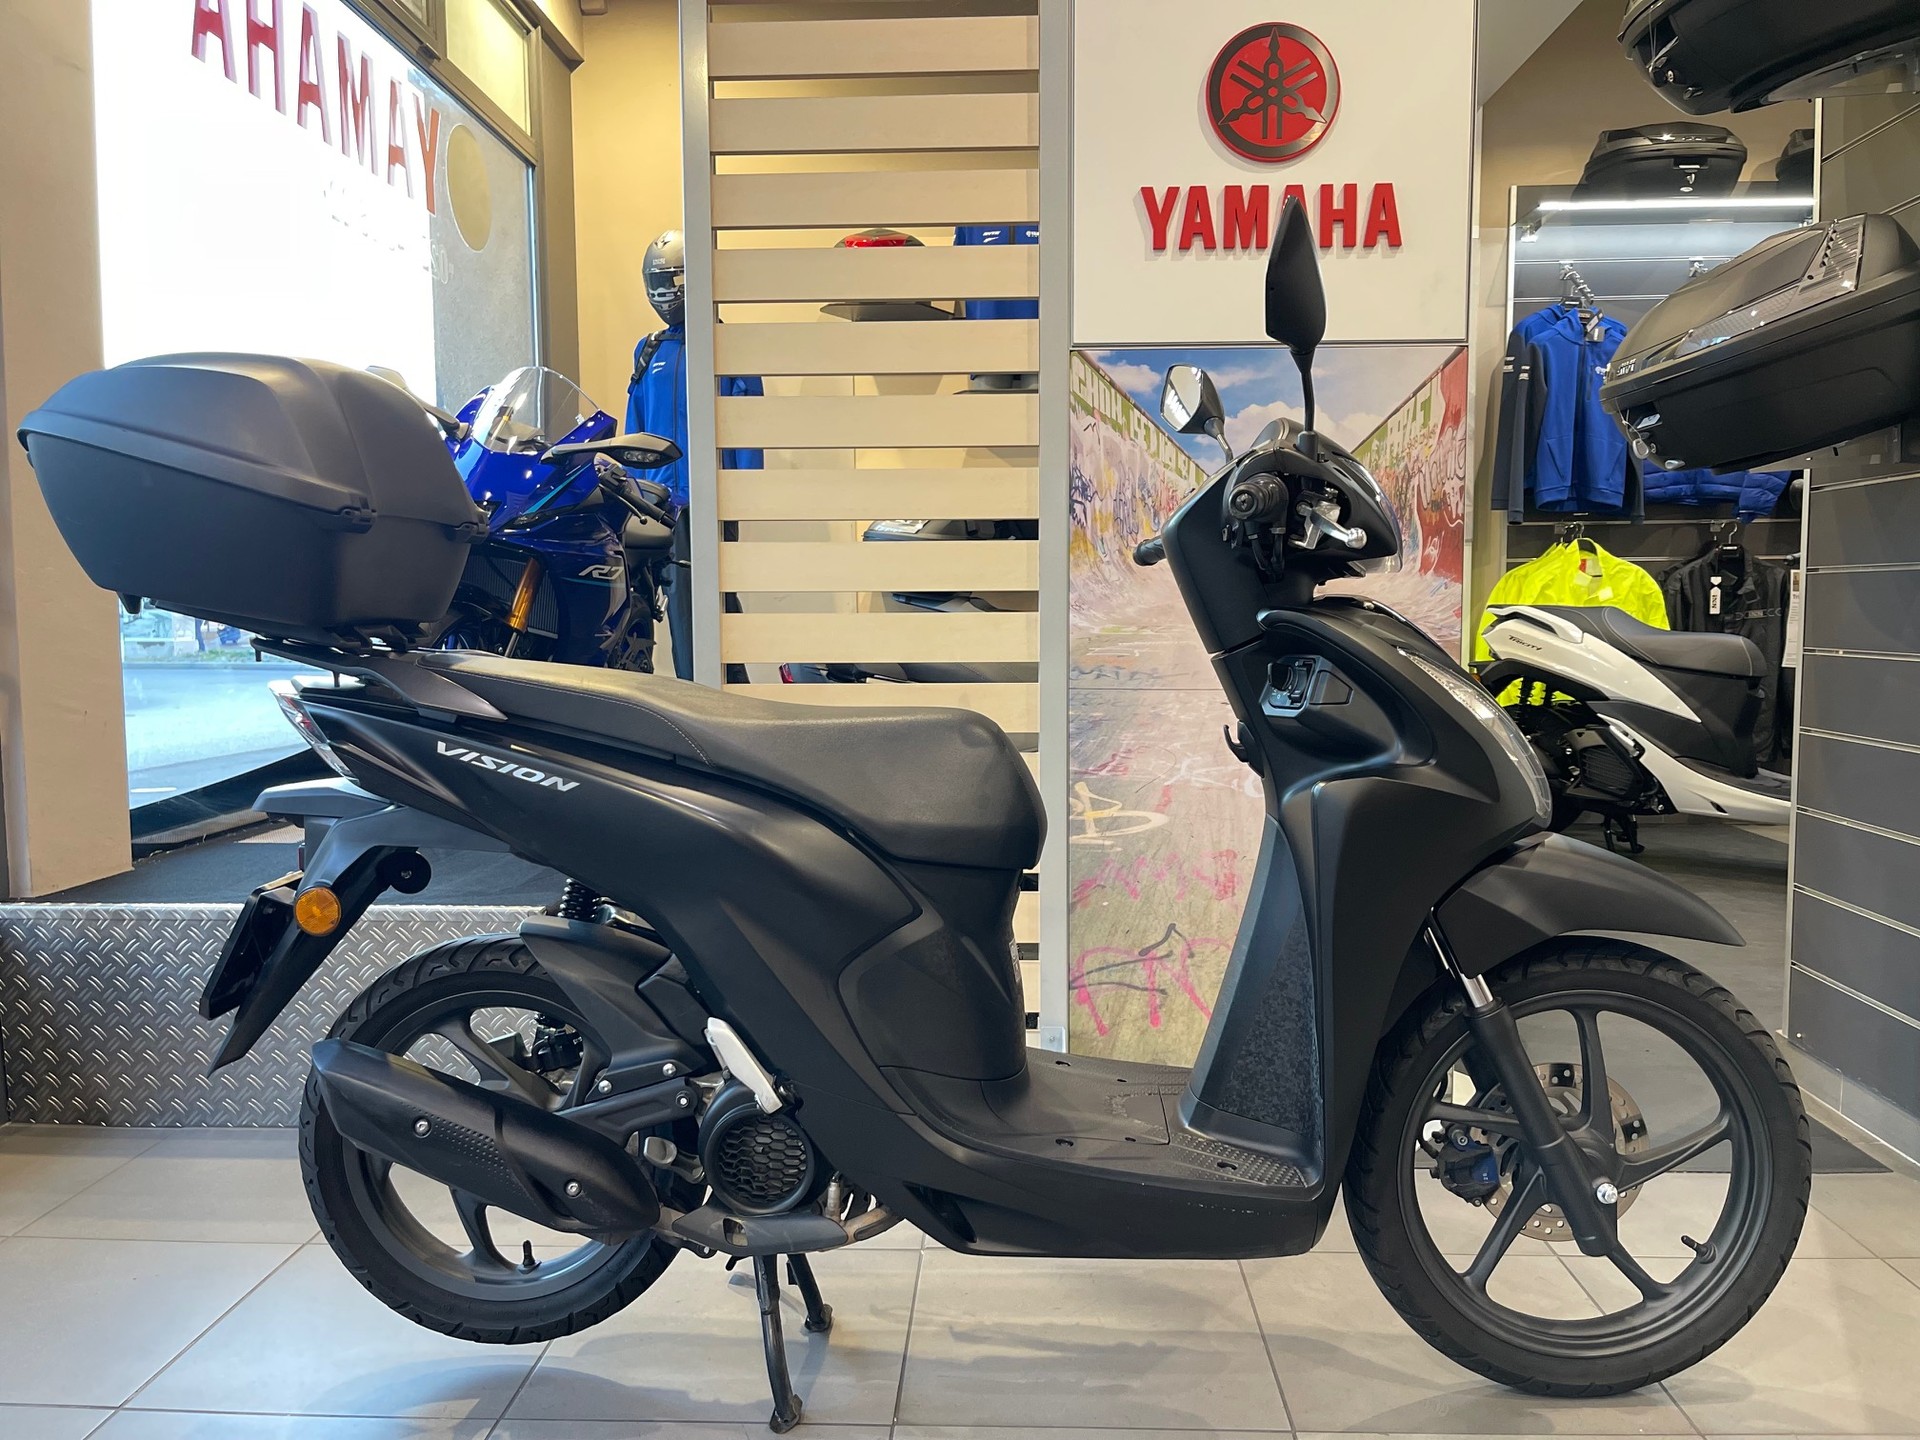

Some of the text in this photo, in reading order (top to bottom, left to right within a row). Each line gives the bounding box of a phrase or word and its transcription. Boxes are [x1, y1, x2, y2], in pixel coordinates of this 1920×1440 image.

[1140, 183, 1403, 251] YAMHA
[578, 564, 625, 580] R7
[437, 740, 580, 792] VISION
